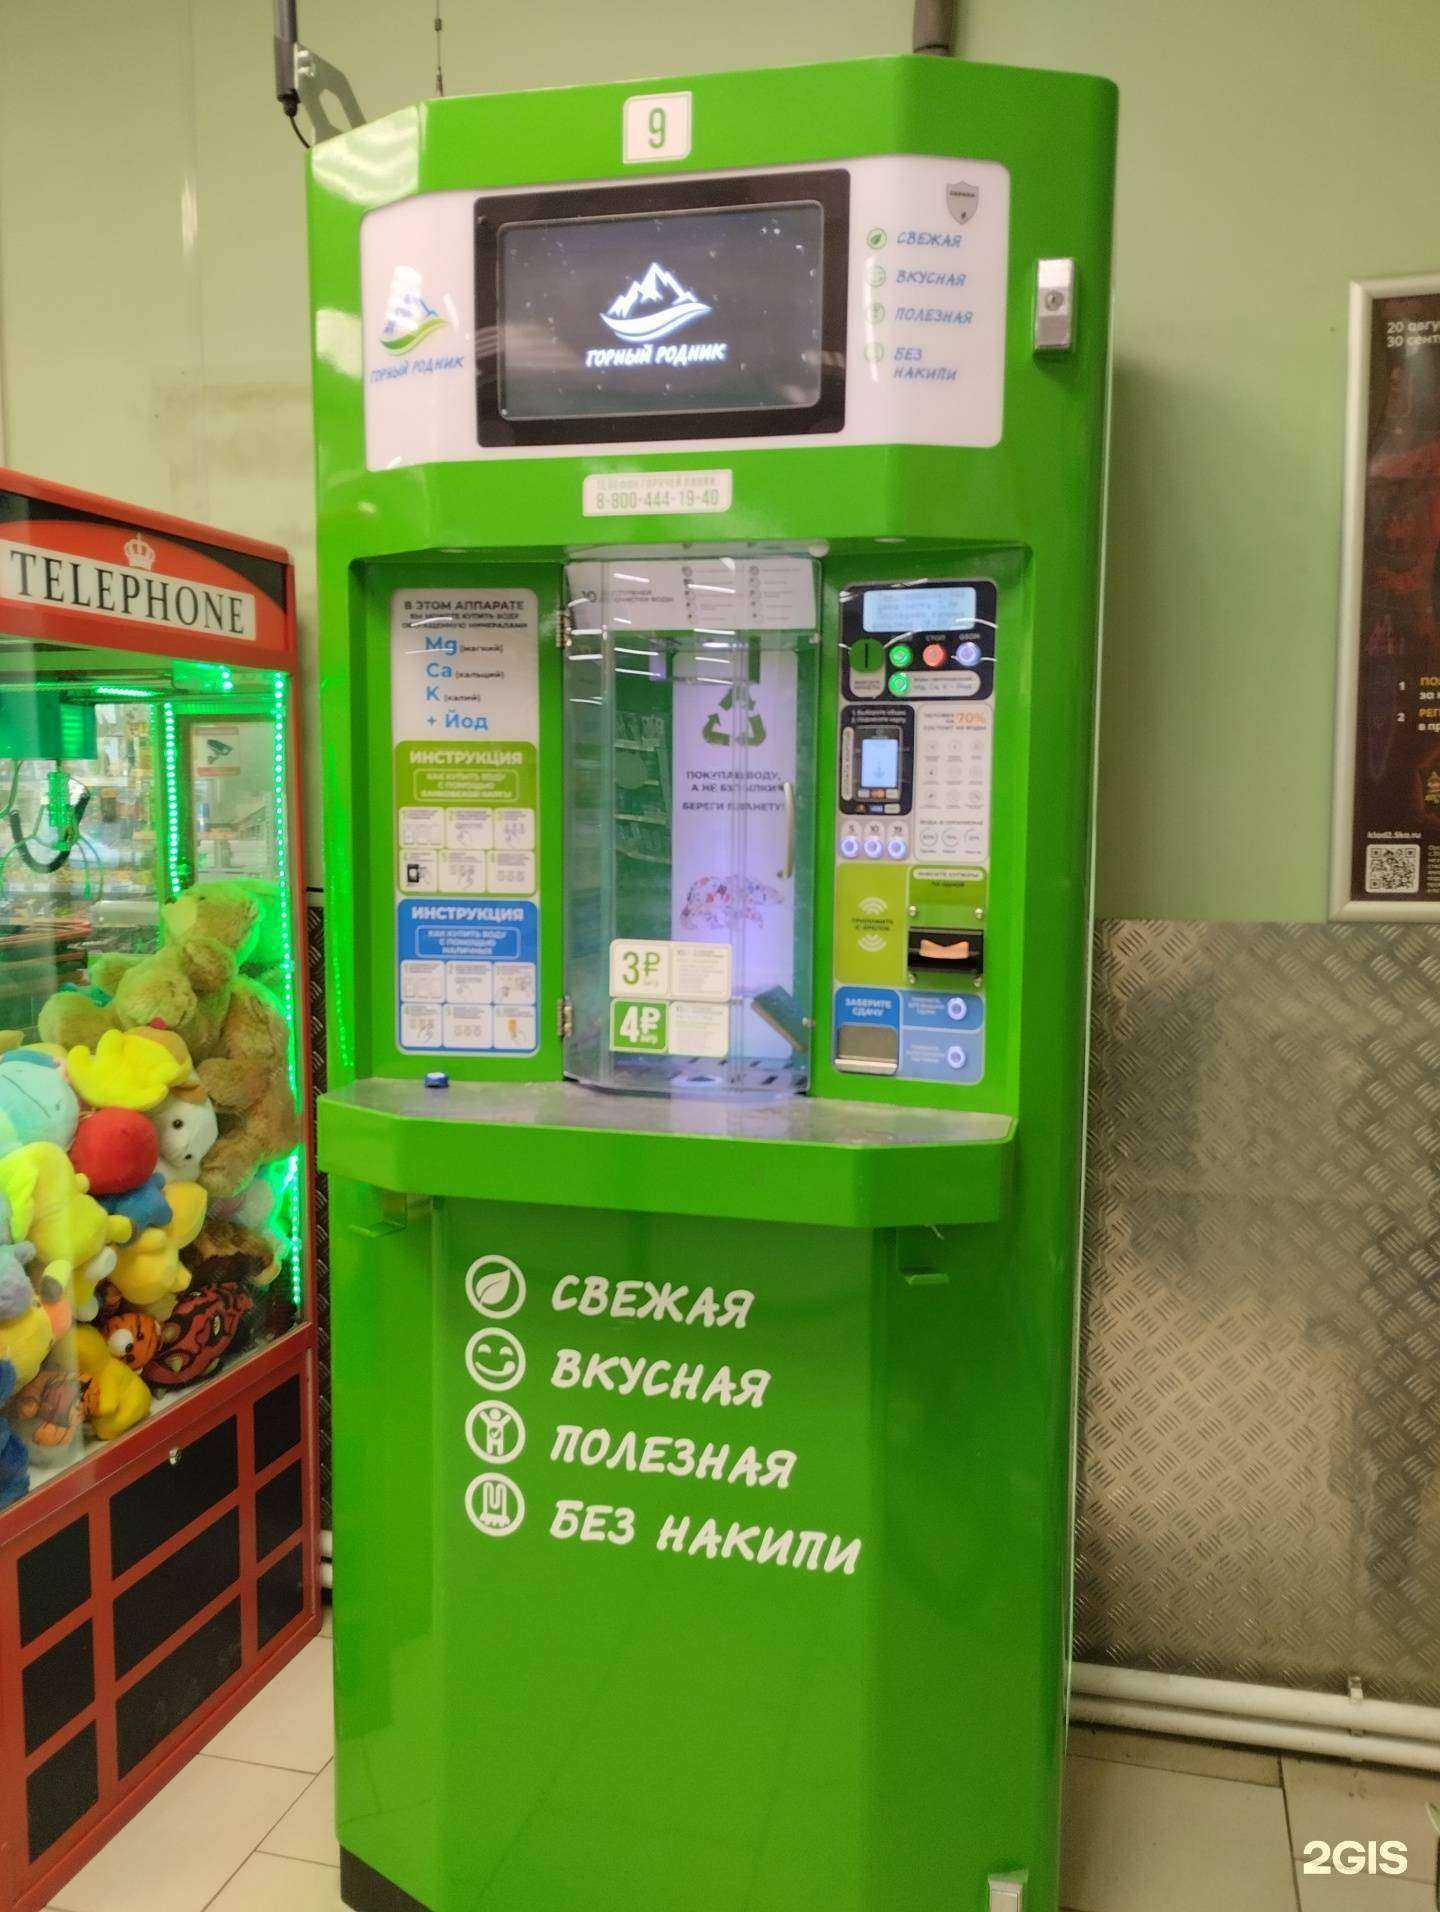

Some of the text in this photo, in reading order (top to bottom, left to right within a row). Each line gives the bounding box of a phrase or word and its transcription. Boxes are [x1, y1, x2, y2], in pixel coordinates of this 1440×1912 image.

[649, 108, 666, 149] 9
[897, 232, 962, 248] СВЕЖАЯ
[896, 270, 967, 286] ВКУСНАЯ
[894, 308, 974, 324] ПОЛЕЗНАЯ
[1387, 321, 1404, 334] 20
[1387, 335, 1403, 348] 30
[585, 343, 727, 368] ГОРНЫЙ РОДНИК
[894, 347, 922, 361] БЕЗ
[412, 356, 464, 374] РОДНИК
[893, 366, 958, 381] НАКИПИ
[596, 489, 720, 510] 8-800-444-19-40
[10, 550, 245, 634] TELEPHONE
[404, 600, 525, 610] В ЭТОМ АППАРАТЕ
[425, 636, 458, 657] Mg
[1398, 681, 1406, 690] 1
[445, 709, 488, 731] Йод
[955, 712, 987, 724] 70%
[1397, 712, 1406, 722] 2
[409, 750, 523, 766] ИНСТРУКЦИЯ
[691, 783, 699, 792] А
[702, 783, 716, 792] НЕ
[682, 802, 724, 811] БЕРЕГИ
[411, 906, 524, 922] ИНСТРУКЦИЯ
[551, 1274, 755, 1329] СВЕЖАЯ
[550, 1348, 772, 1408] ВКУСНАЯ
[550, 1424, 798, 1489] ПОЛЕЗНАЯ
[549, 1500, 862, 1575] БЕЗ НАКИПИ
